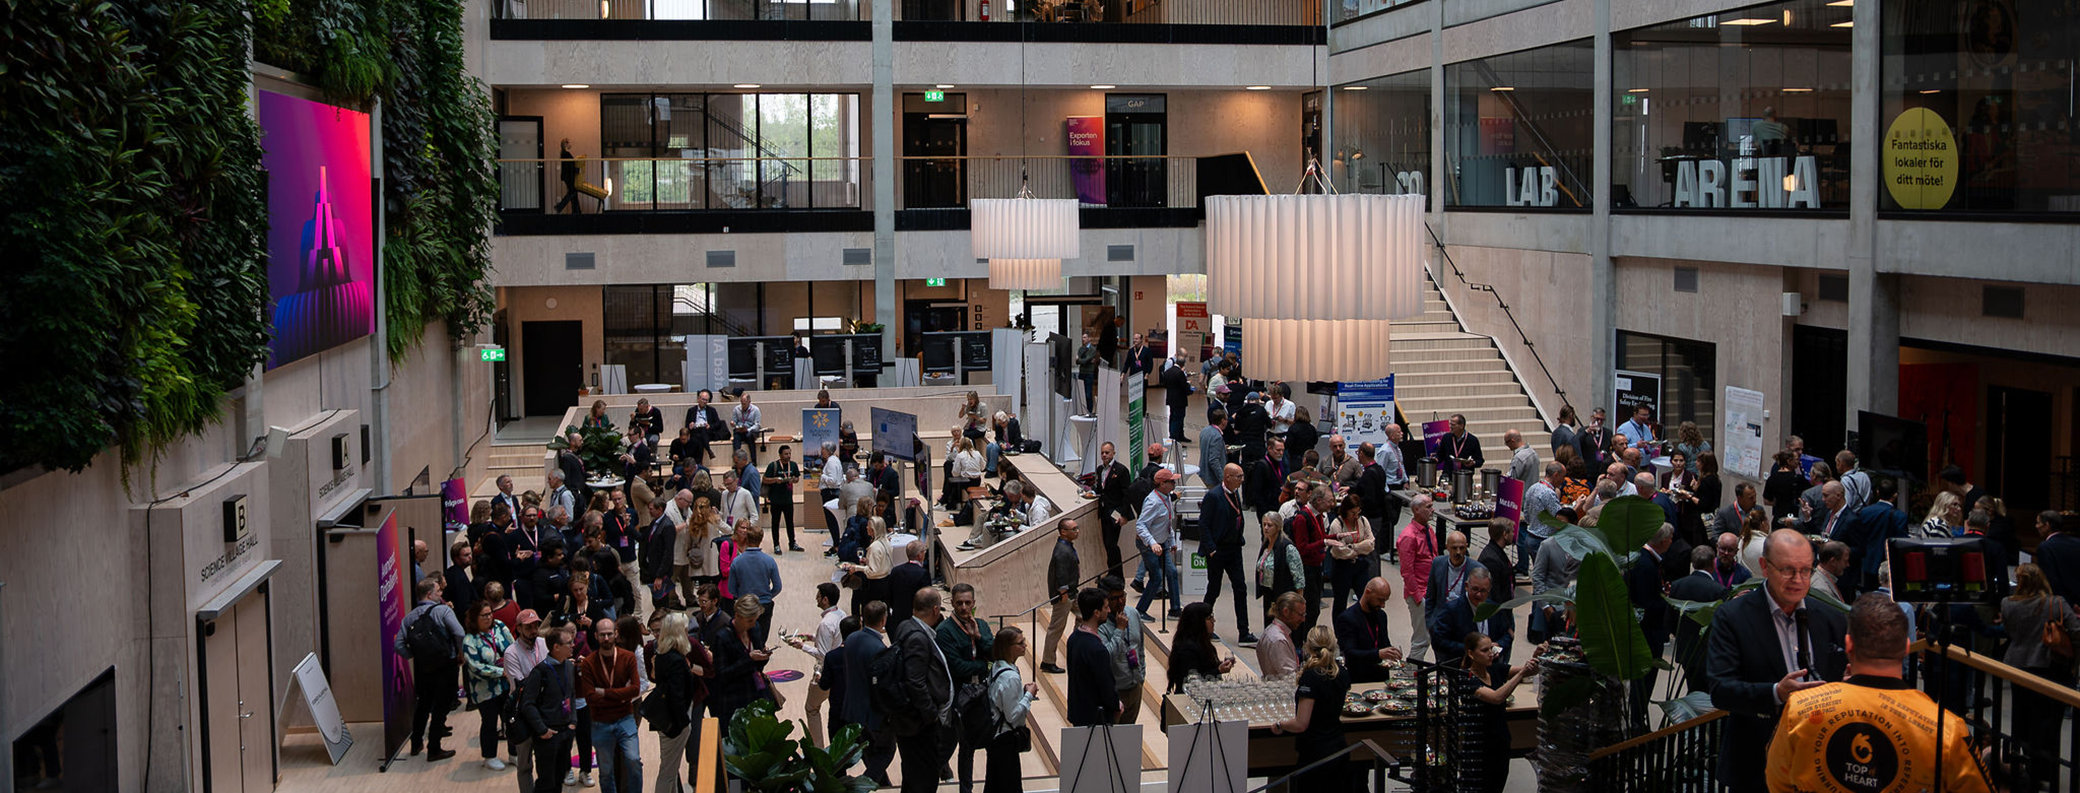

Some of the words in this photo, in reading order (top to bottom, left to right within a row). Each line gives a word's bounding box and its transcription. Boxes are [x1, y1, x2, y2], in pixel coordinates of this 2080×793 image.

[1127, 100, 1145, 108] GAP
[1069, 131, 1098, 140] Experten
[1892, 139, 1947, 151] Fantastiska
[1895, 157, 1927, 168] lokaler
[1930, 157, 1944, 168] för
[1505, 166, 1559, 207] LAB
[1674, 155, 1821, 208] ARENA
[1897, 175, 1913, 186] ditt
[1916, 175, 1944, 186] möte!
[1186, 320, 1199, 331] DA
[1619, 399, 1632, 408] Safety
[1623, 393, 1639, 401] Division
[344, 442, 349, 463] A
[319, 480, 334, 500] SCIENCE
[239, 505, 246, 532] B
[201, 555, 225, 583] SCIENCE
[225, 541, 246, 565] VILLAGE
[246, 533, 259, 550] HALL
[1828, 709, 1893, 731] REPUTATION
[1815, 727, 1829, 754] YOUR
[1893, 731, 1909, 756] INTO
[1815, 759, 1842, 793] URNING
[1845, 762, 1869, 776] TOP
[1845, 773, 1879, 788] HEART
